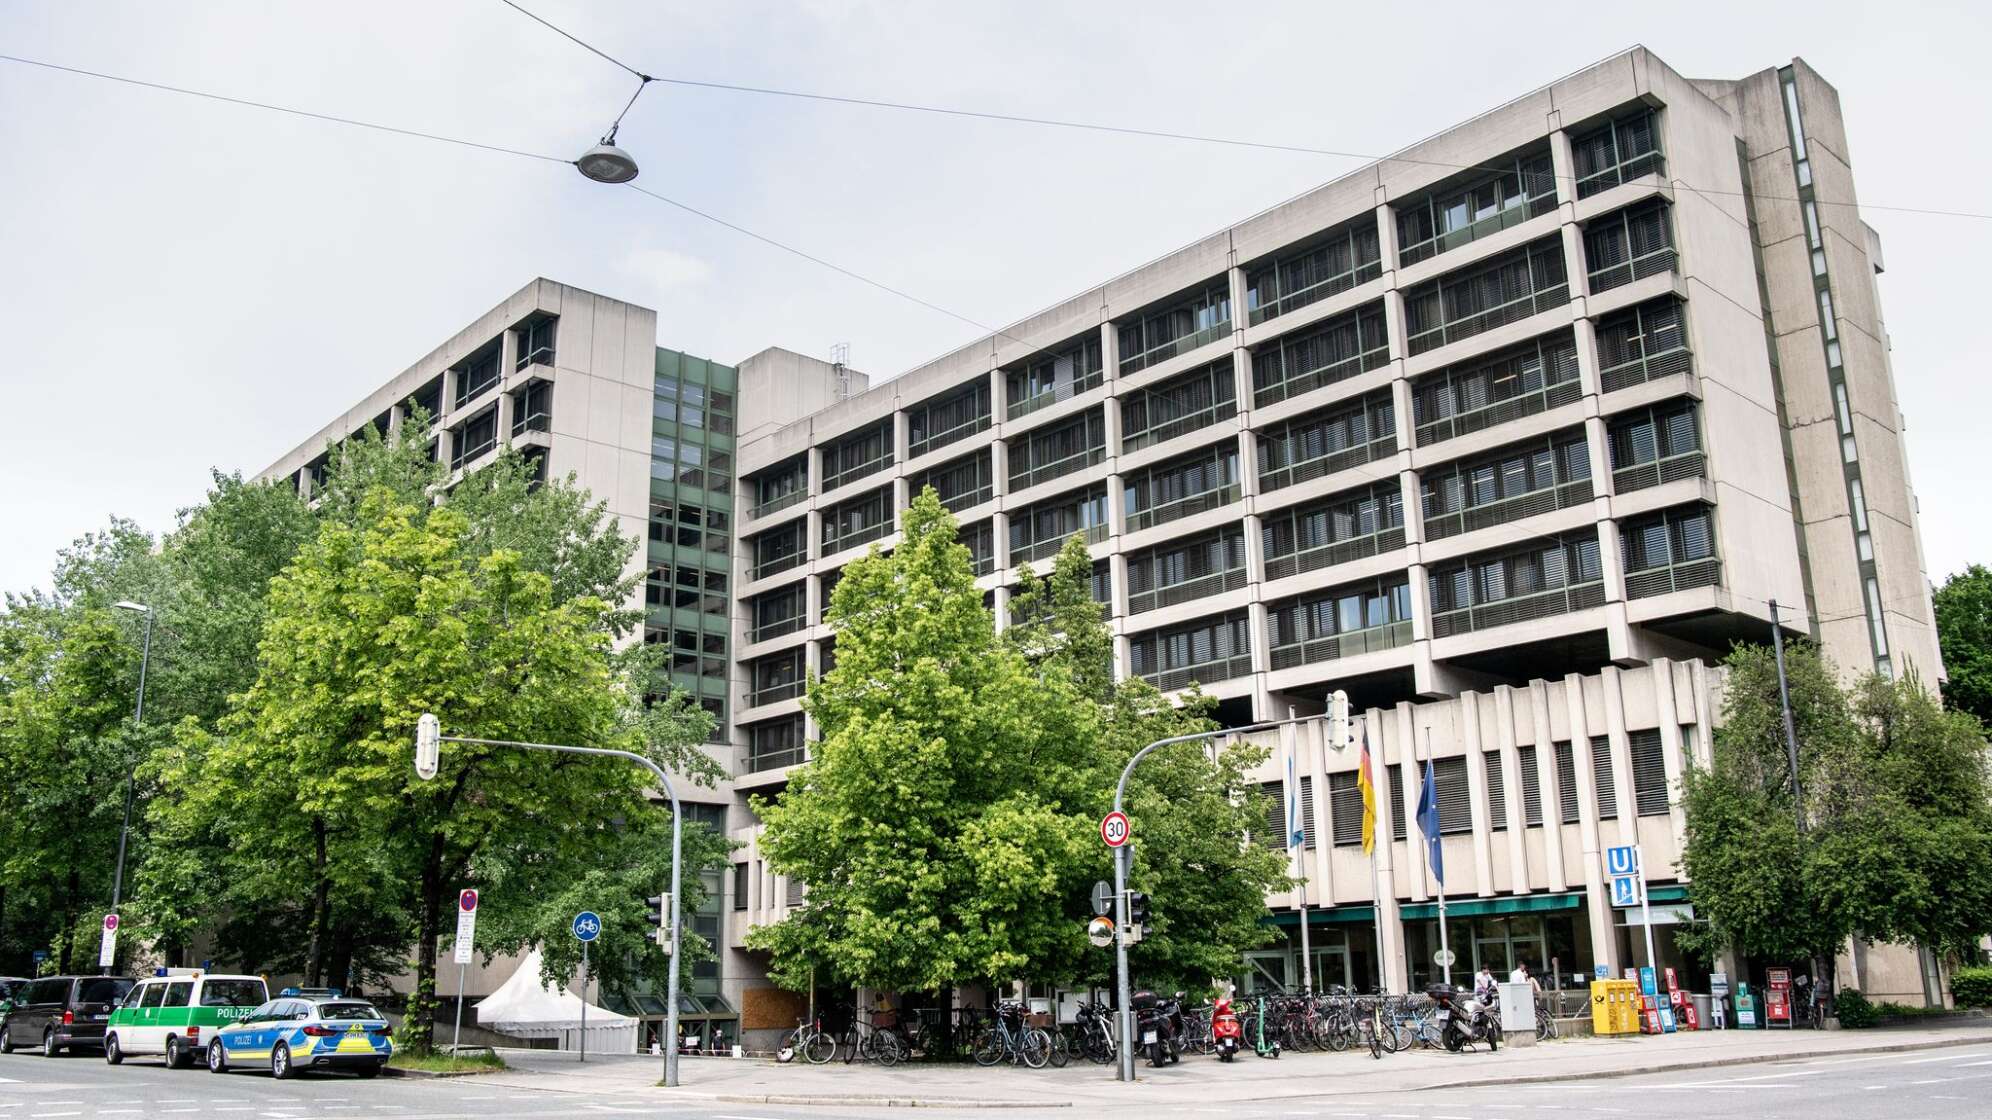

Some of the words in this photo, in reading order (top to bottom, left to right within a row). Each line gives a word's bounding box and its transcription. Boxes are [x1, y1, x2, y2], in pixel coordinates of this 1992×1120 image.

[1107, 821, 1124, 837] 30
[1612, 849, 1629, 871] U
[234, 1035, 252, 1045] POLIZEI
